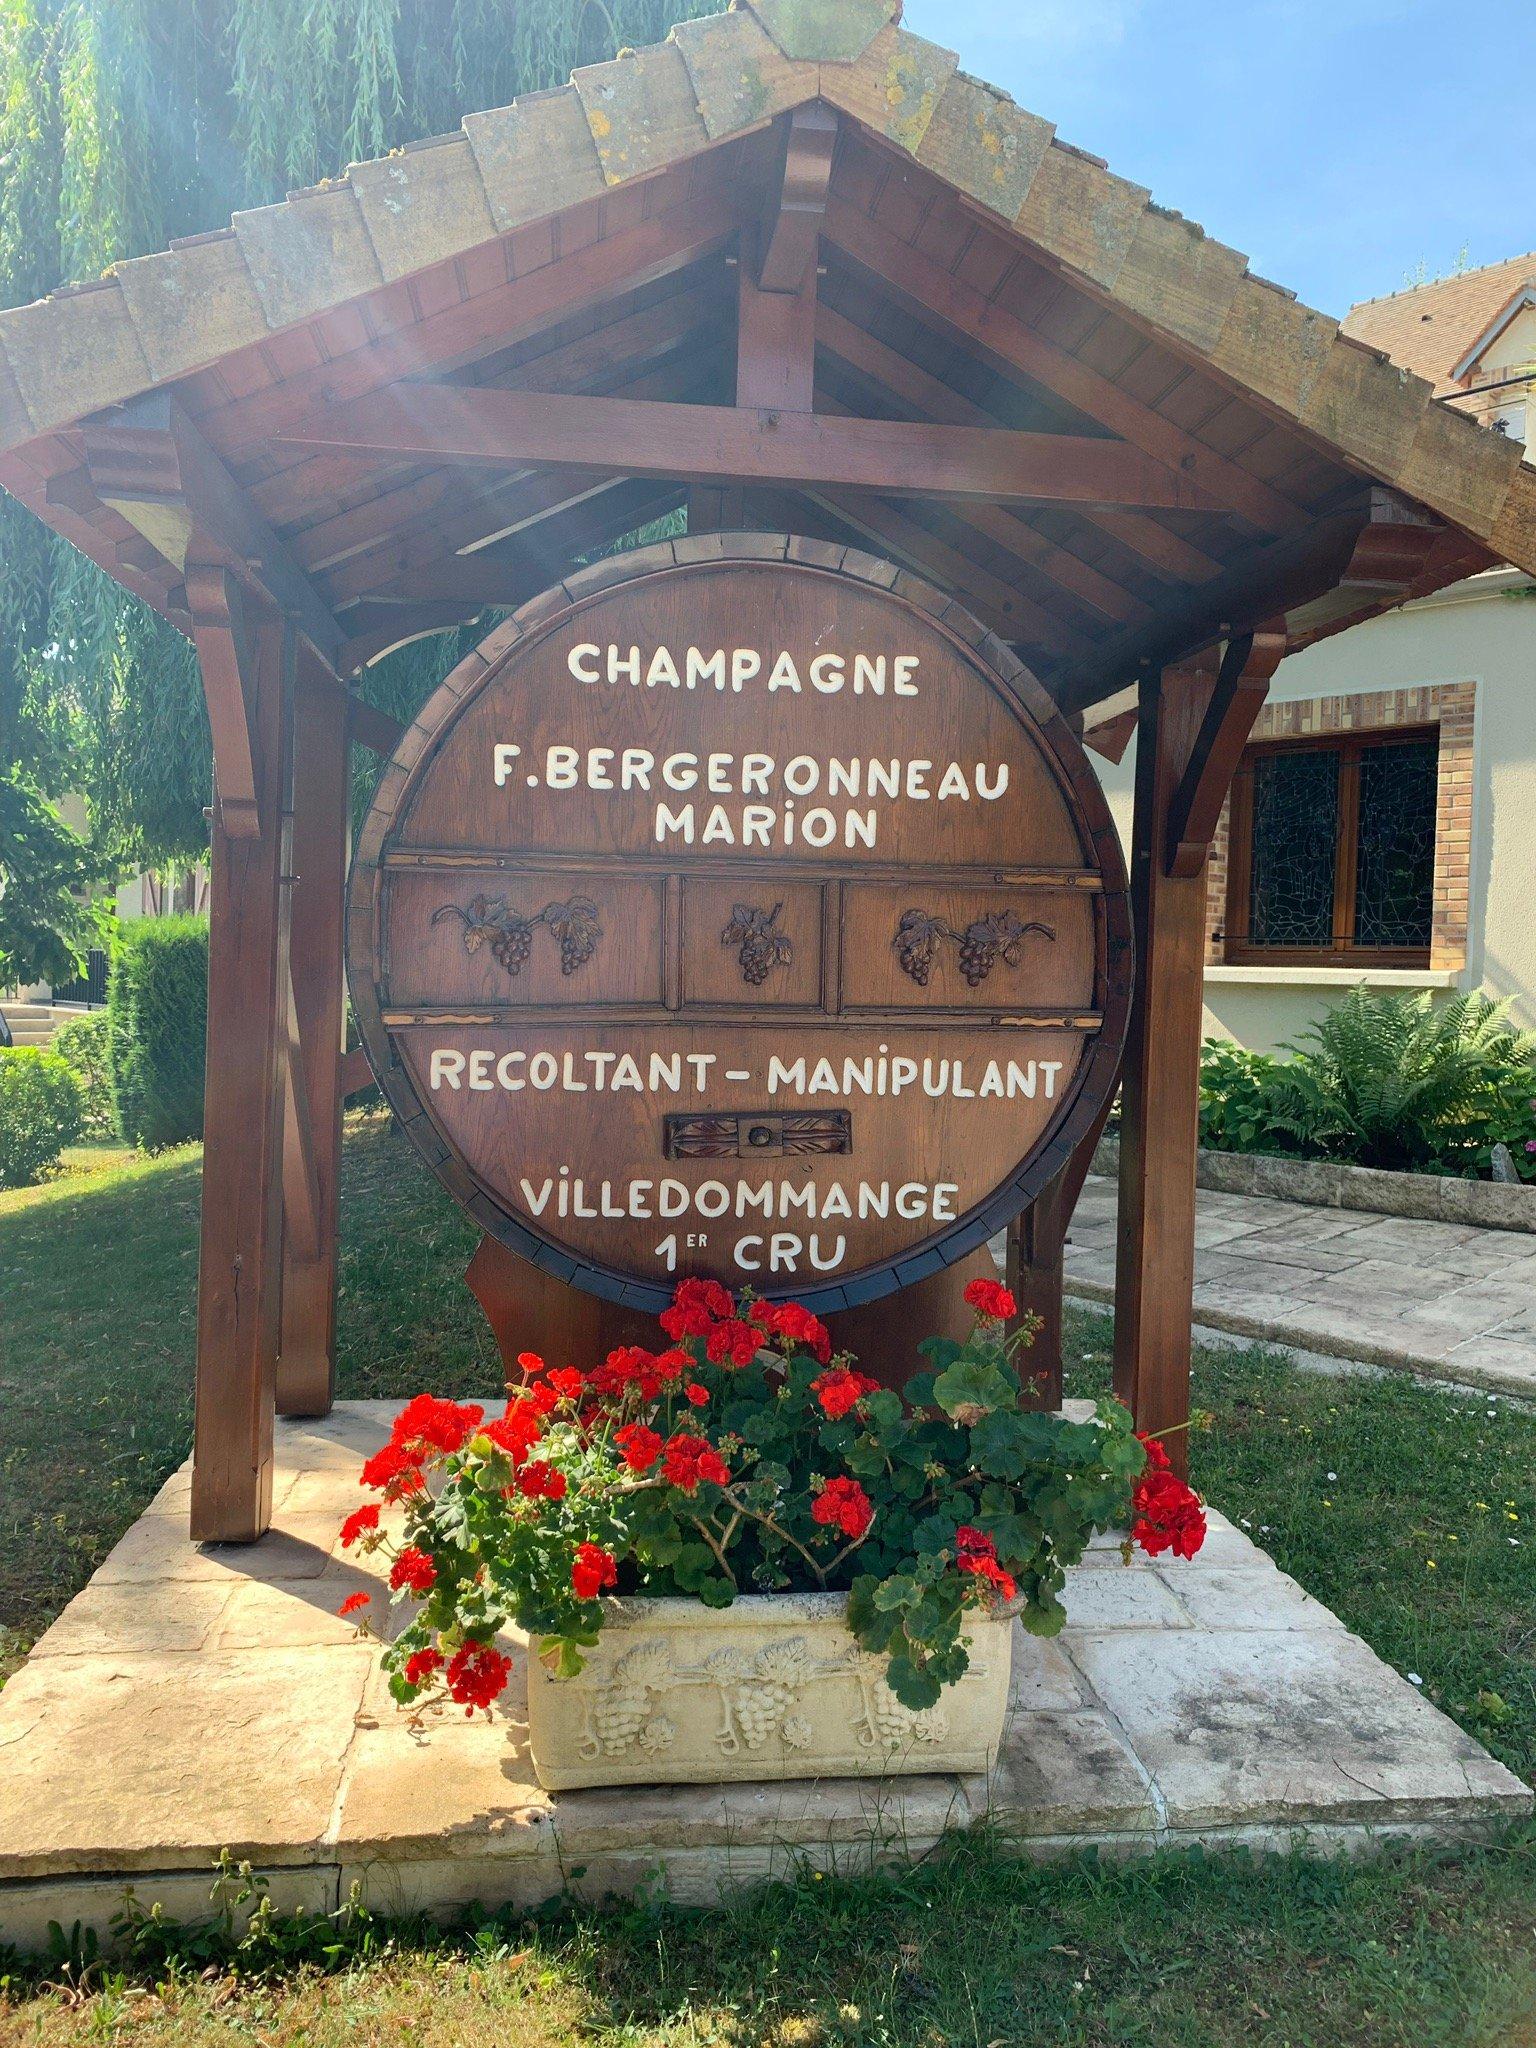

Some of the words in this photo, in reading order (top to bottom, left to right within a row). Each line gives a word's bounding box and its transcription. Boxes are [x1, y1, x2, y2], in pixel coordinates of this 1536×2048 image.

[567, 642, 922, 697] CHAMPAGNE
[429, 1049, 717, 1093] RECOLTANT
[733, 1232, 848, 1273] CRU
